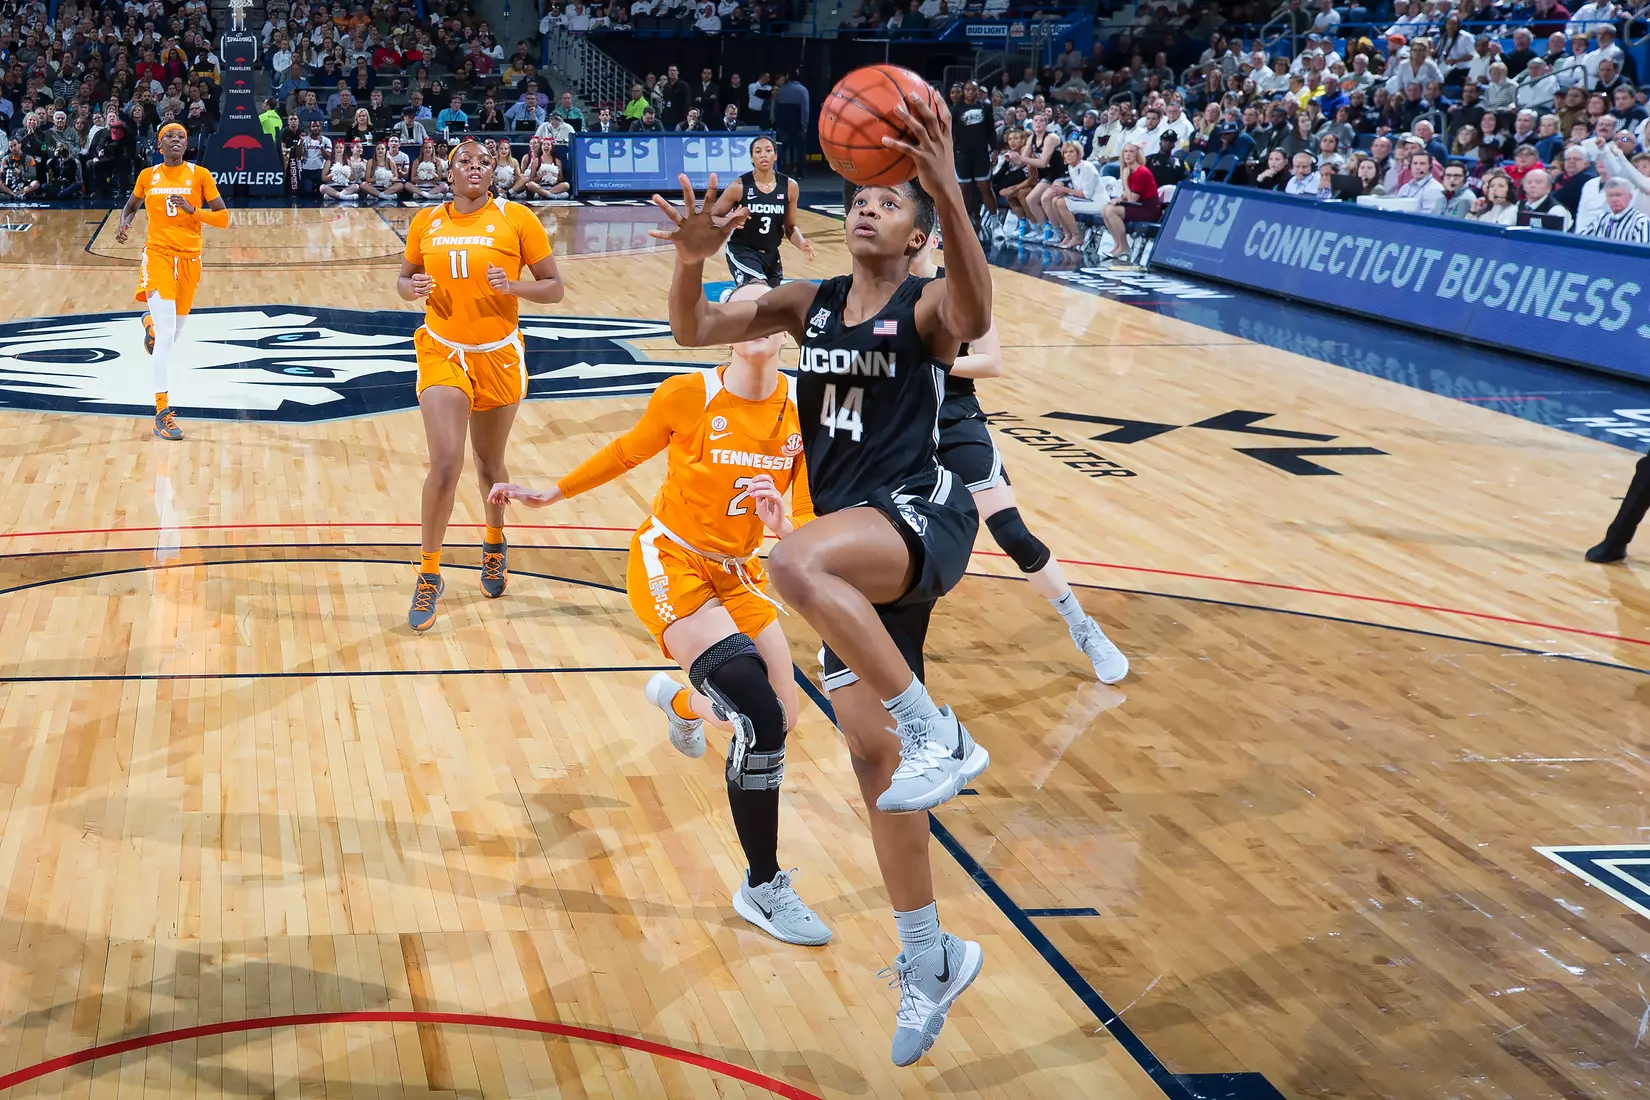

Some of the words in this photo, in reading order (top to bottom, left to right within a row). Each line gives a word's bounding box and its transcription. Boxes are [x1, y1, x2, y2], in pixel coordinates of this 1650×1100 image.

[967, 26, 983, 35] BUD
[985, 26, 1006, 35] LIGHT
[210, 171, 284, 186] RAVELERS
[289, 158, 299, 190] HUSKIES
[150, 187, 192, 196] TENNESSEE
[747, 203, 785, 215] UCONN
[758, 216, 772, 234] 3
[431, 235, 495, 247] TENNESSEE
[448, 249, 469, 279] 11
[1244, 219, 1444, 293] CONNECTICUT
[1436, 253, 1642, 331] BUSINESS
[799, 345, 897, 378] UCONN
[819, 383, 865, 443] 44
[1000, 427, 1138, 478] CENTER
